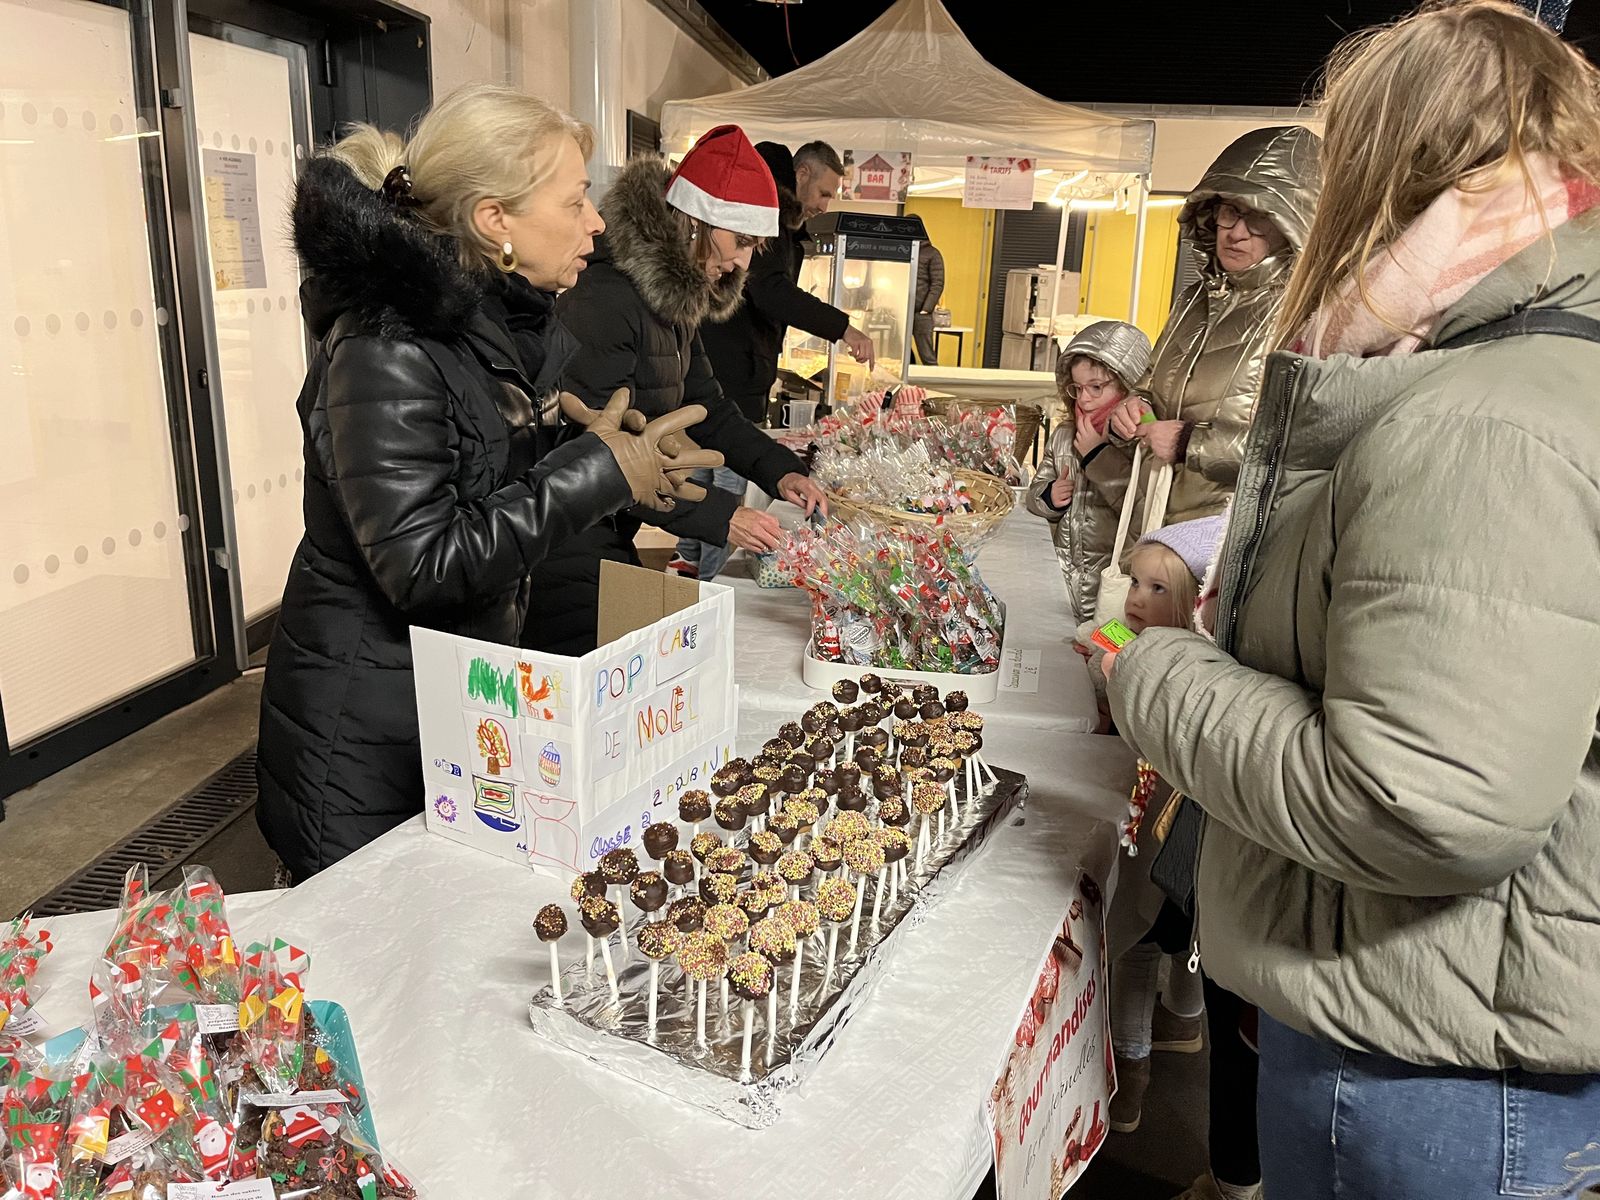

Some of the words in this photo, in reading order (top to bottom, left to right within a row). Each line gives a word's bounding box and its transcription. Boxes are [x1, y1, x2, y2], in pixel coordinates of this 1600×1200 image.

[990, 166, 1012, 175] TARIFS
[867, 174, 884, 184] BAR
[596, 653, 644, 708] POP
[659, 624, 698, 656] CAKE
[604, 731, 621, 759] DE
[652, 789, 663, 807] 2
[516, 842, 527, 851] A4
